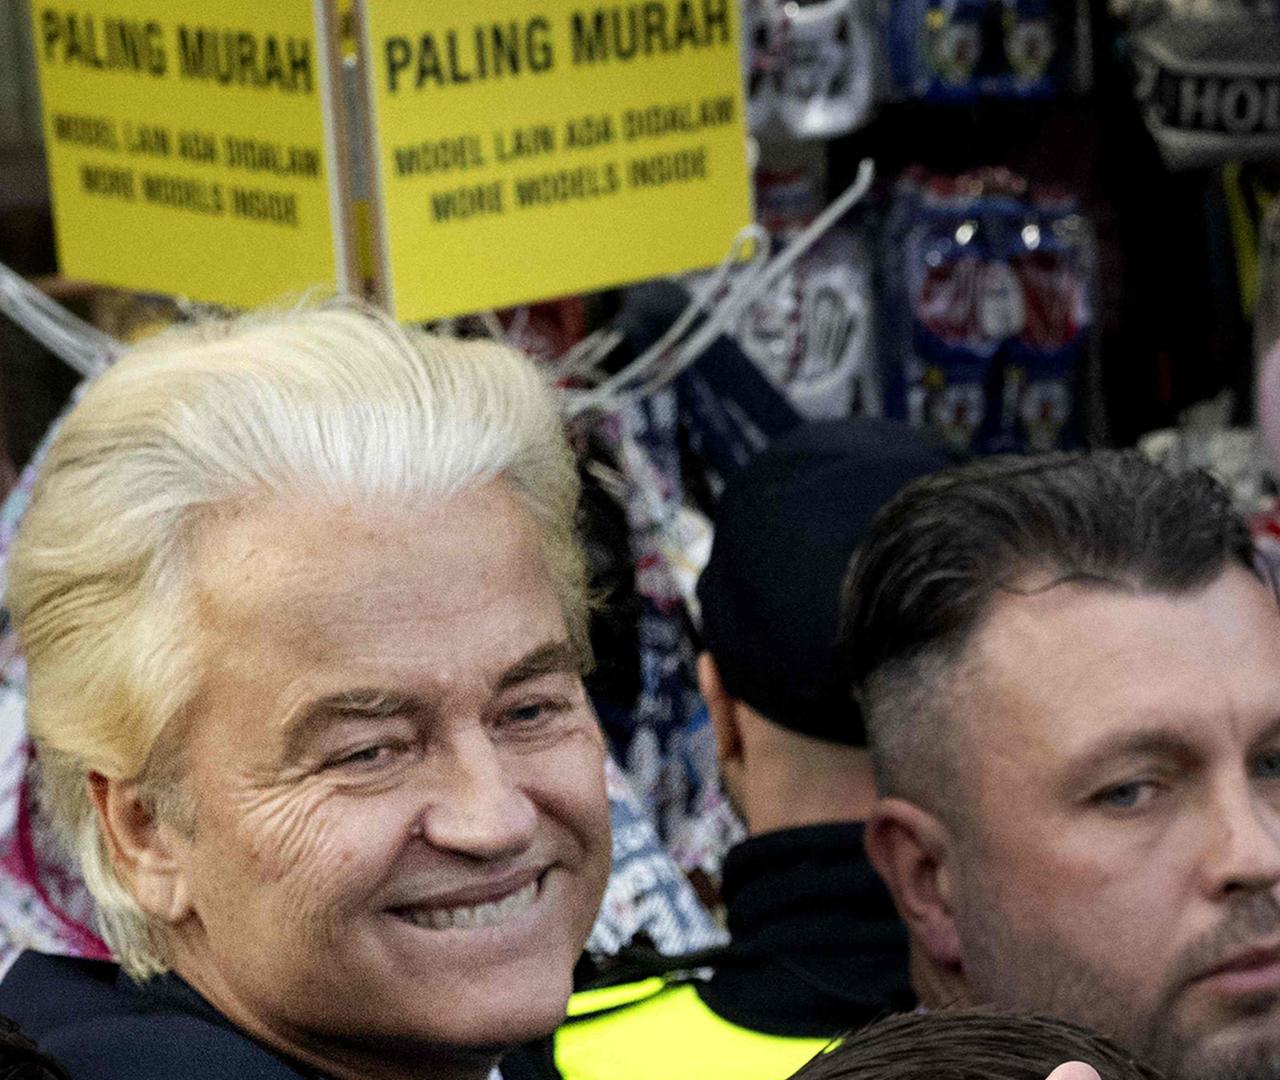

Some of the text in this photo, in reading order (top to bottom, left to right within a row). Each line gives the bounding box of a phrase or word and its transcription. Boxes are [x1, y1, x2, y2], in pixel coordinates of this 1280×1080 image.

[41, 8, 314, 94] PALING MURAH
[384, 0, 732, 93] PALING MURAH
[54, 113, 319, 179] MODEL LAIN ADA DIDALAM
[394, 97, 734, 178] MODEL LAIN ADA DIDALAM
[81, 165, 298, 227] MORE MODELS INSIDE
[431, 147, 708, 223] MORE MODELS INSIDE
